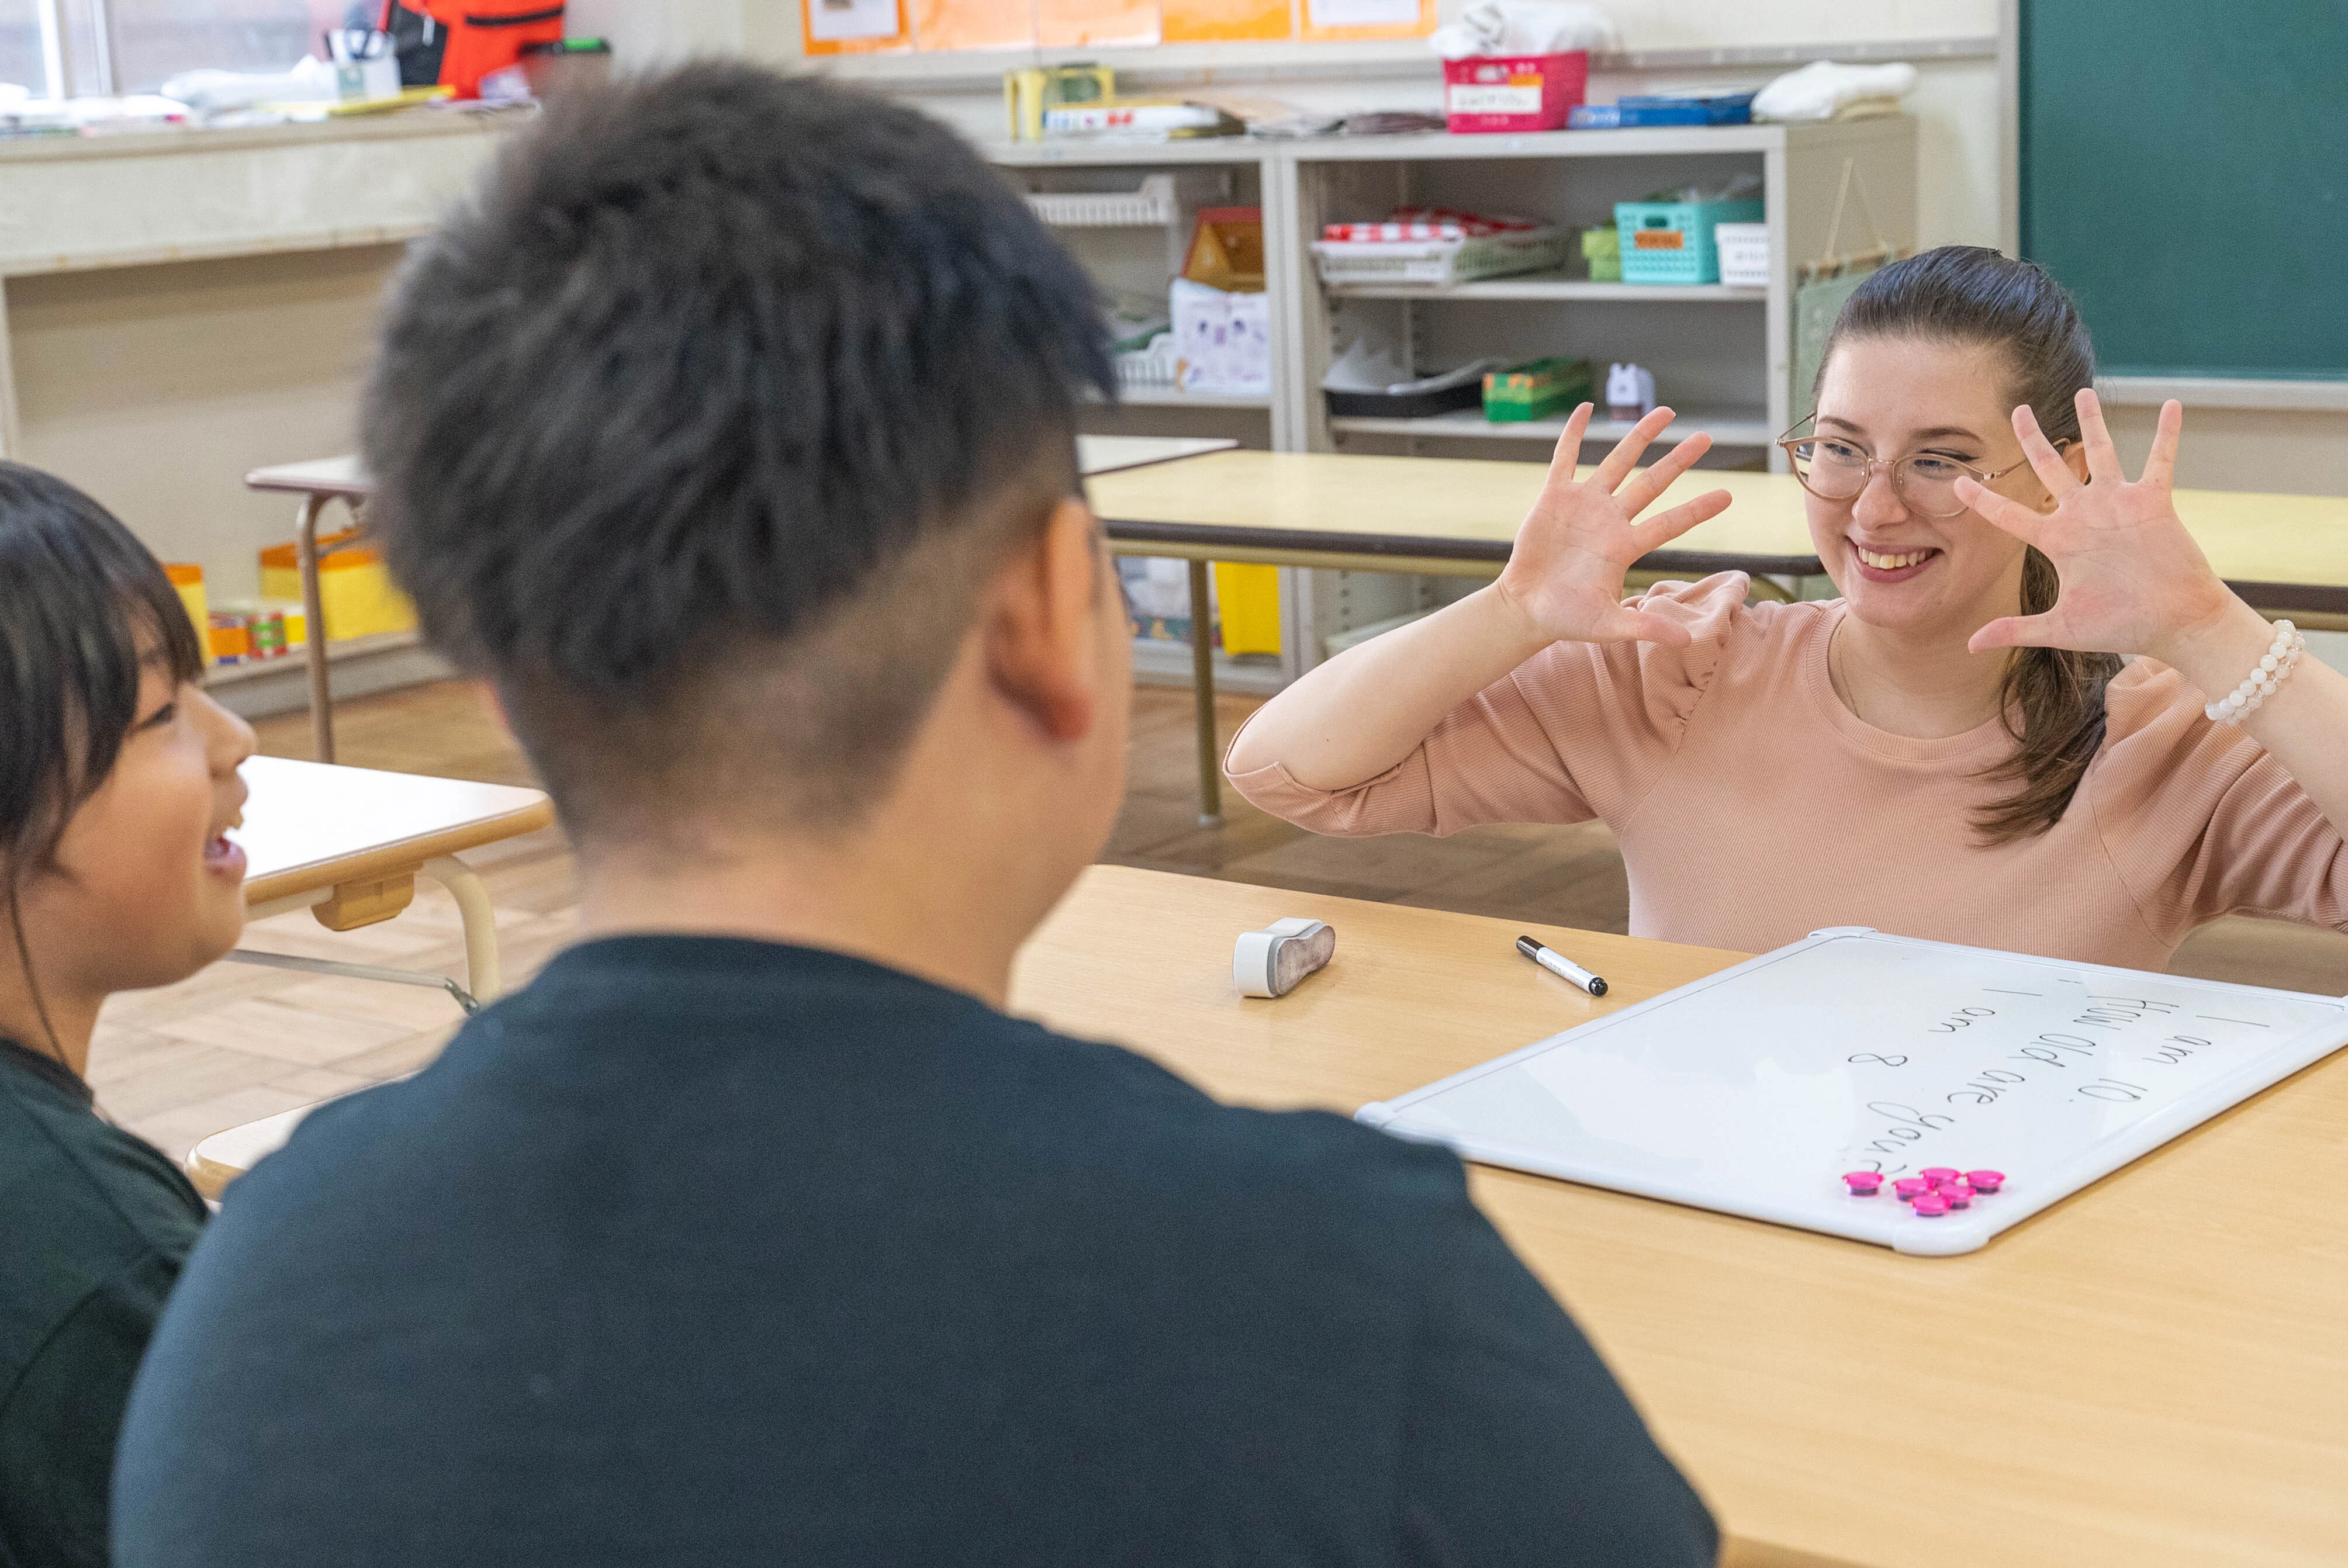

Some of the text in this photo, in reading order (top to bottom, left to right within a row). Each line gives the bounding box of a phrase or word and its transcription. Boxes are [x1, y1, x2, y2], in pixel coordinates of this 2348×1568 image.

[1847, 988, 2043, 1068] I am 8
[2072, 995, 2180, 1031] How
[1946, 1069, 2027, 1105] are
[2069, 1015, 2271, 1103] I am 10.
